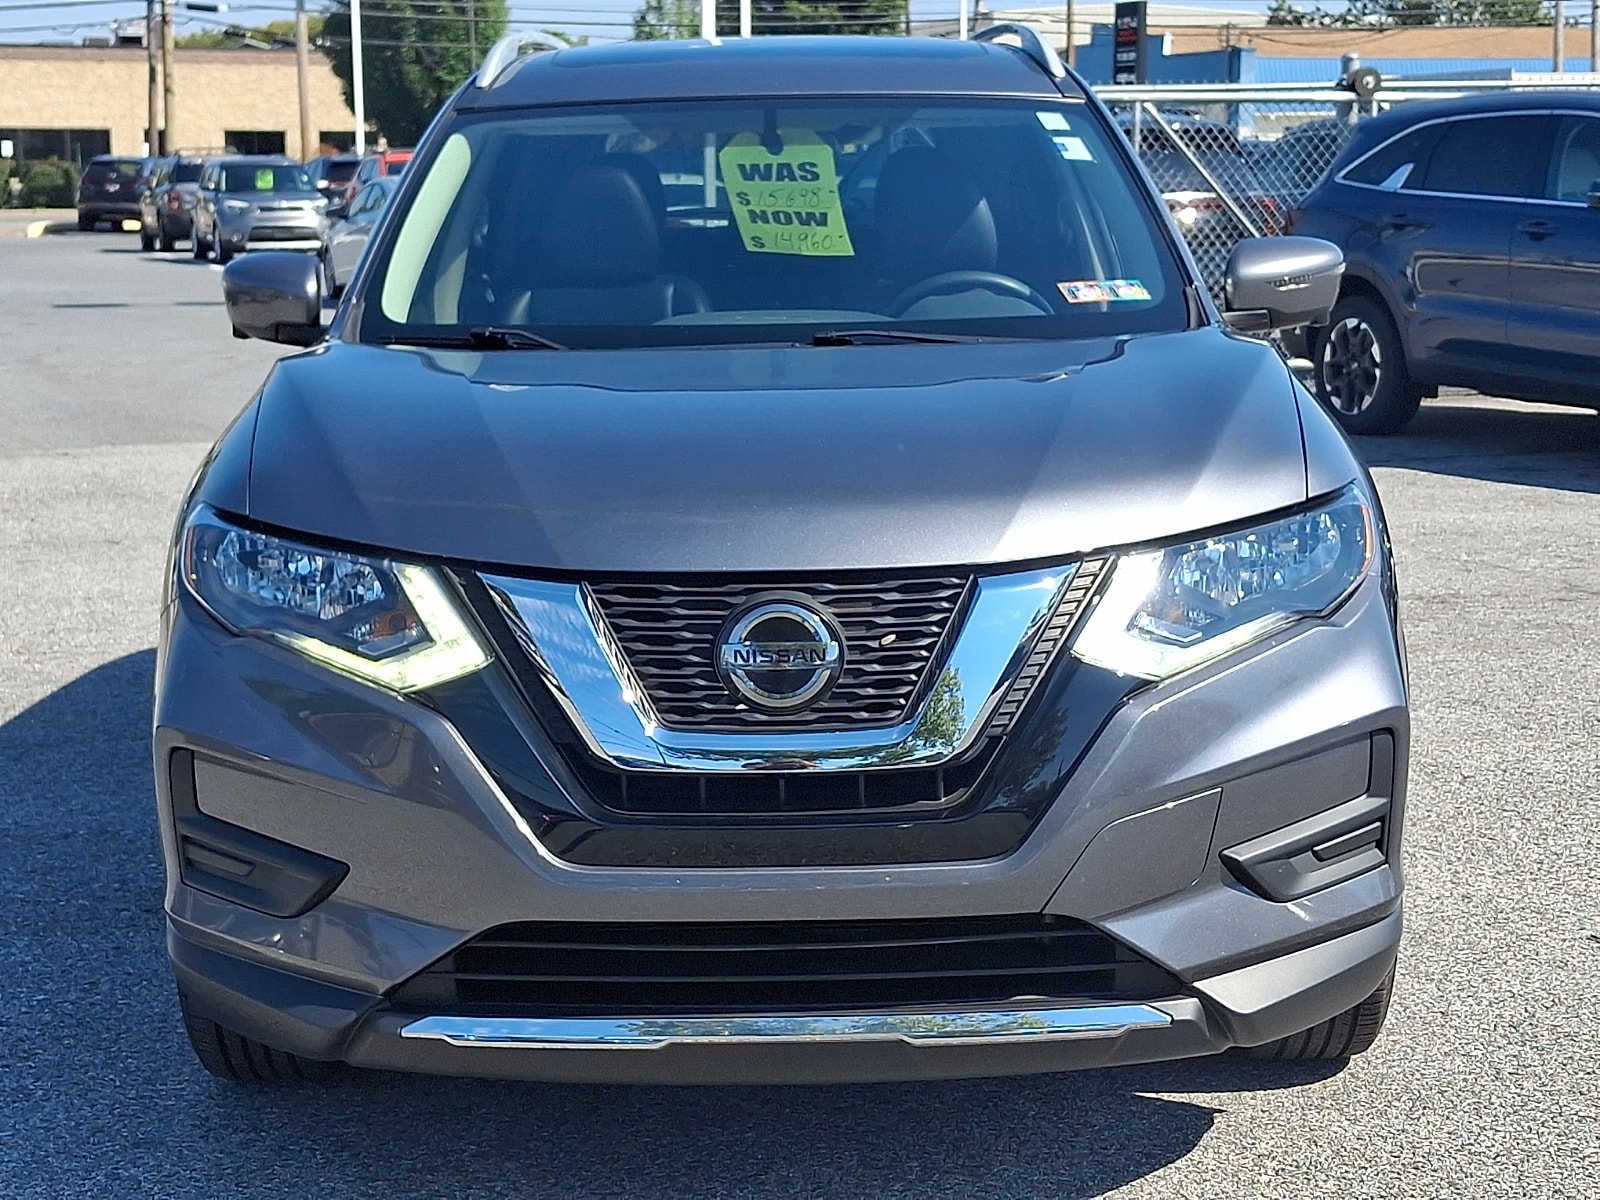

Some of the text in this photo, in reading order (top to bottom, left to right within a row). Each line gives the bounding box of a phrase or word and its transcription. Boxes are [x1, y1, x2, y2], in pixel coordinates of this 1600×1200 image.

[737, 162, 820, 182] WAS
[747, 209, 829, 228] NOW
[733, 648, 827, 664] NISSAN
